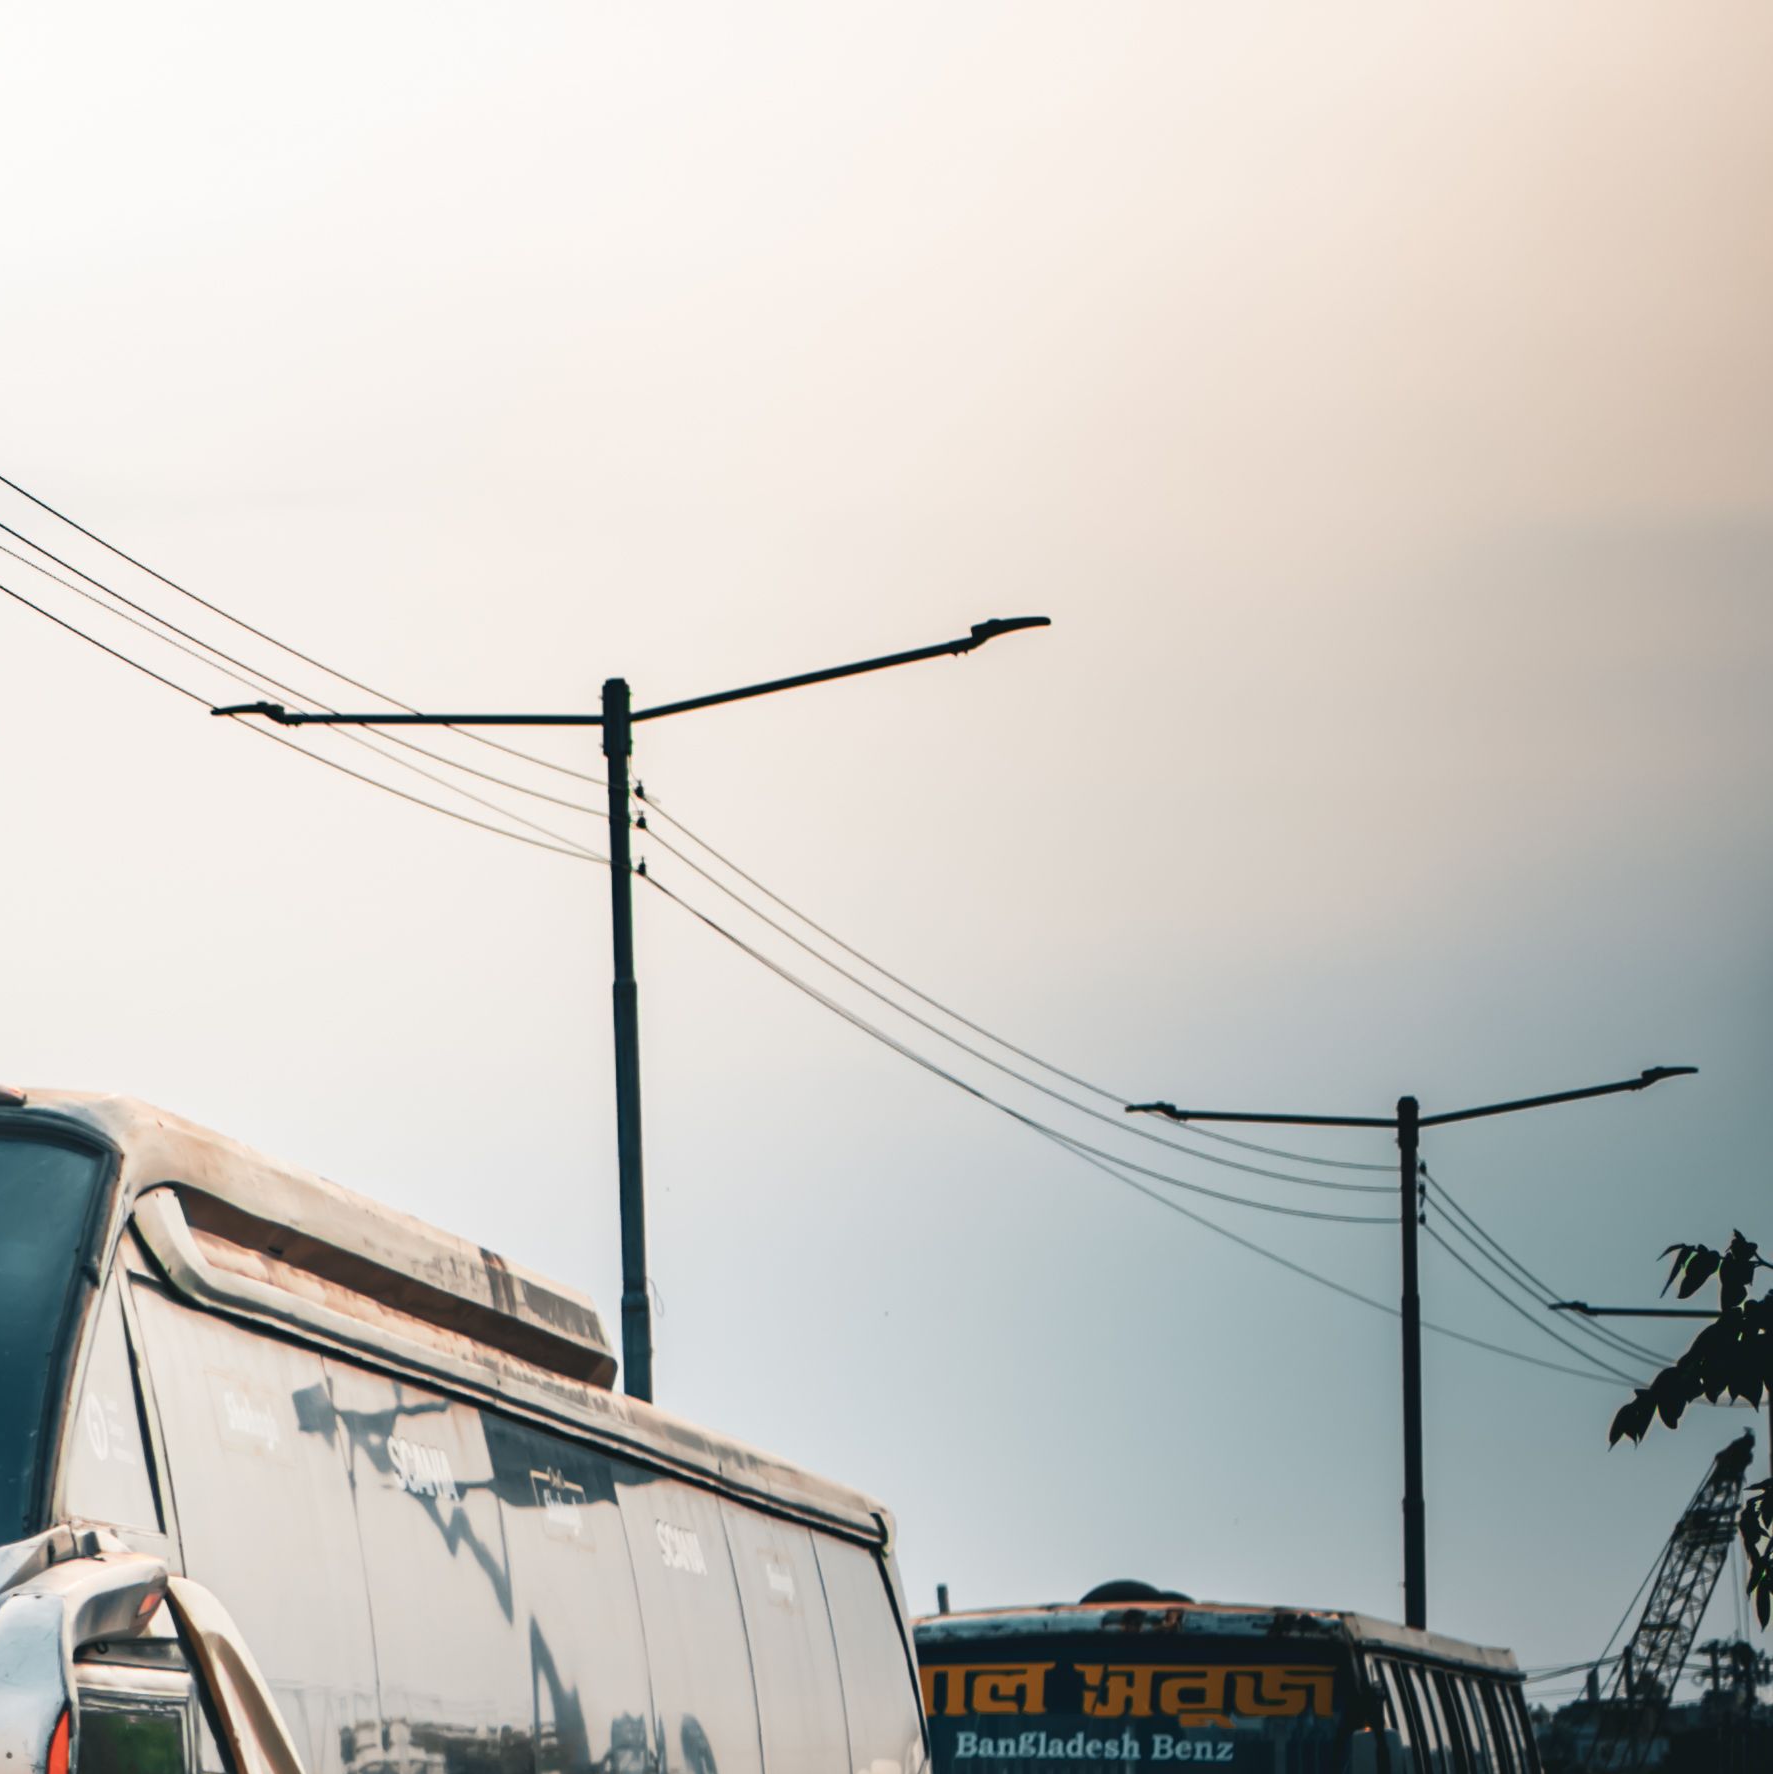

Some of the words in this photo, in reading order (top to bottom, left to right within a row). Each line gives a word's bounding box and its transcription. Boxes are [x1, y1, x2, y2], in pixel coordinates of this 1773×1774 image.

[919, 1662, 1056, 1717] াল
[1074, 1663, 1337, 1729] সবুজ
[956, 1732, 1141, 1760] Bangladesh
[1151, 1734, 1233, 1761] Benz
